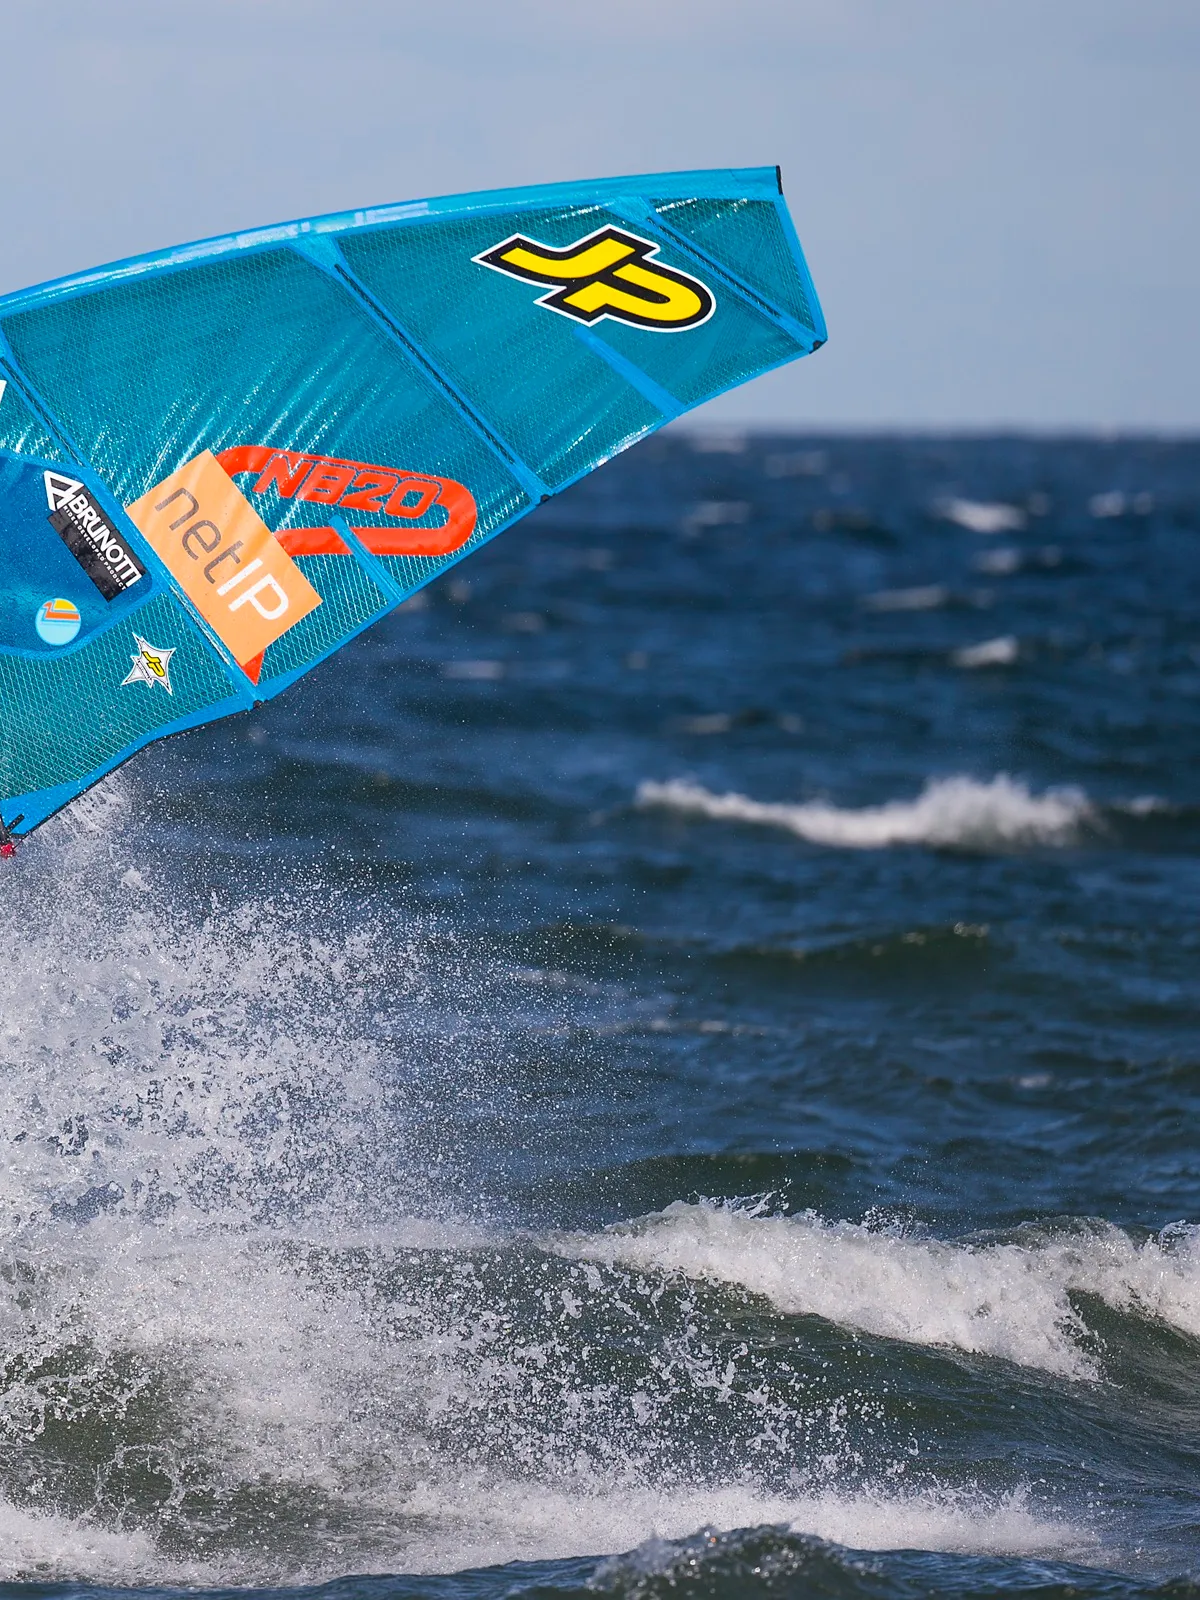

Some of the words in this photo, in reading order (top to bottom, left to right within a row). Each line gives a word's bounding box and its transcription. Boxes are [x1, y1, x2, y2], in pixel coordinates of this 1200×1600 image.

[478, 227, 712, 329] JP
[63, 505, 79, 526] RIDER
[77, 525, 105, 562] DEVELOPED
[103, 561, 126, 591] PRODUCT
[68, 493, 142, 588] BRUNOTTI
[155, 486, 289, 620] netIP
[141, 650, 166, 678] JP
